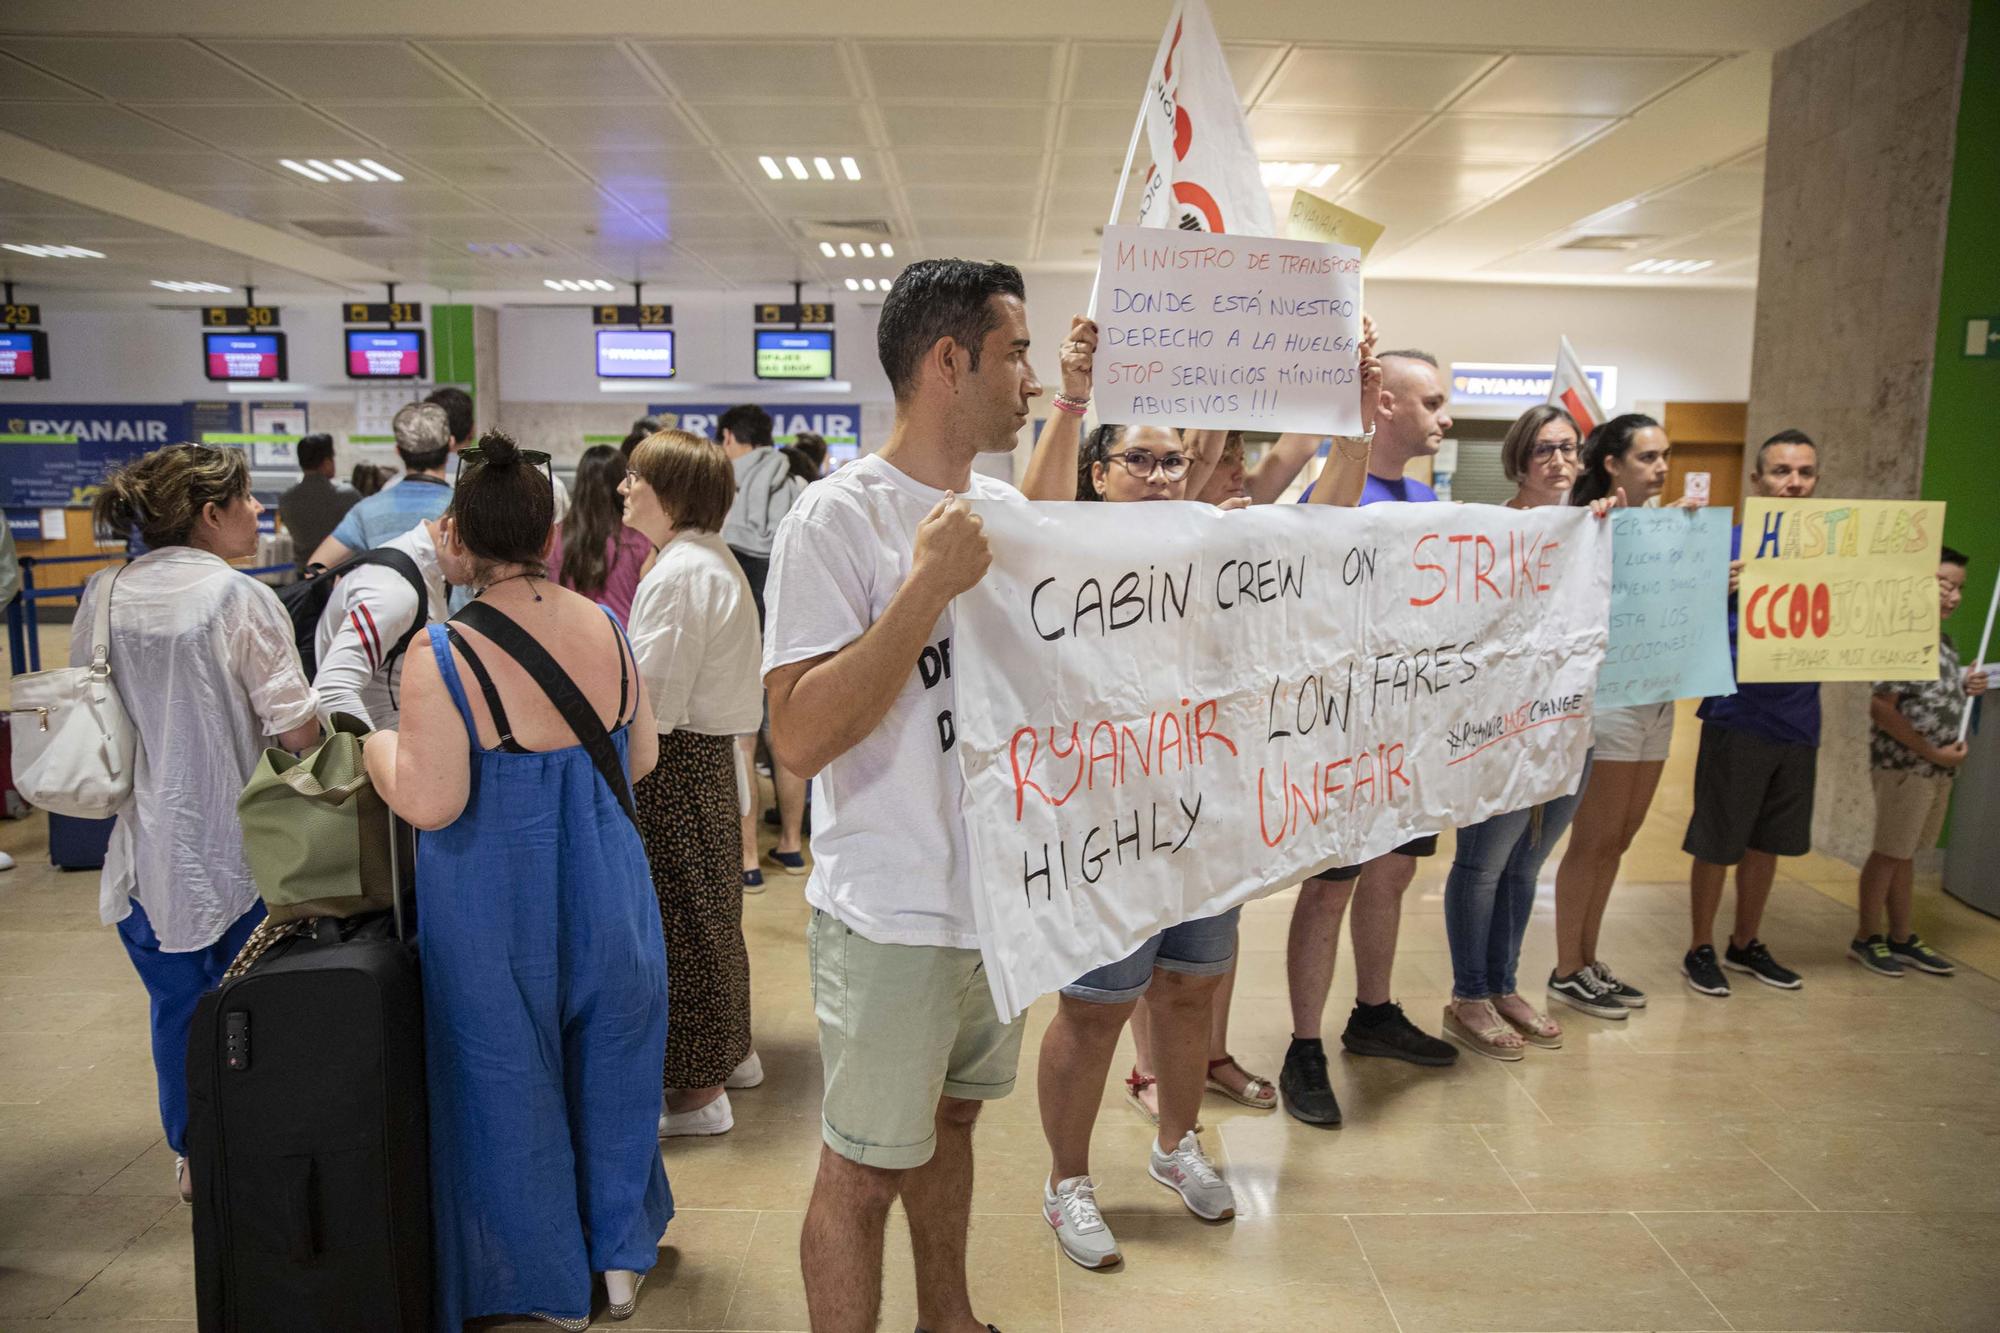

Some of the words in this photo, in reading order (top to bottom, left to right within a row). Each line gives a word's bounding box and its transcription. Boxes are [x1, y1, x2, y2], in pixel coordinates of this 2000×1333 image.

[1116, 240, 1235, 273] MINISTRO
[1247, 252, 1270, 271] DE
[4, 304, 31, 324] 29
[246, 306, 272, 325] 30
[389, 303, 414, 321] 31
[639, 306, 665, 323] 32
[802, 305, 827, 322] 33
[1112, 288, 1196, 314] DONDE
[1212, 290, 1264, 316] ESTÁ
[1270, 299, 1353, 318] NUESTRO
[1107, 326, 1214, 348] DERECHO
[1227, 329, 1241, 348] A
[1252, 331, 1276, 350] LA
[1285, 333, 1356, 353] HUELGA
[1106, 361, 1164, 385] STOP
[1132, 393, 1239, 416] ABUSIVOS
[29, 419, 168, 442] RYANAIR
[682, 413, 853, 438] RNAIR
[1755, 506, 1860, 560] HASTA
[1031, 563, 1192, 641] CABIN
[1216, 555, 1305, 610] CREW
[1342, 547, 1377, 586] ON
[1409, 530, 1560, 607] STRIKE
[1745, 576, 1935, 640] CCOOJONES
[1009, 696, 1239, 822] RYANAIR
[1268, 662, 1353, 744] LOW
[1371, 641, 1478, 718] FARES
[1023, 792, 1202, 909] HIGHLY
[1258, 742, 1411, 848] UNFAIR
